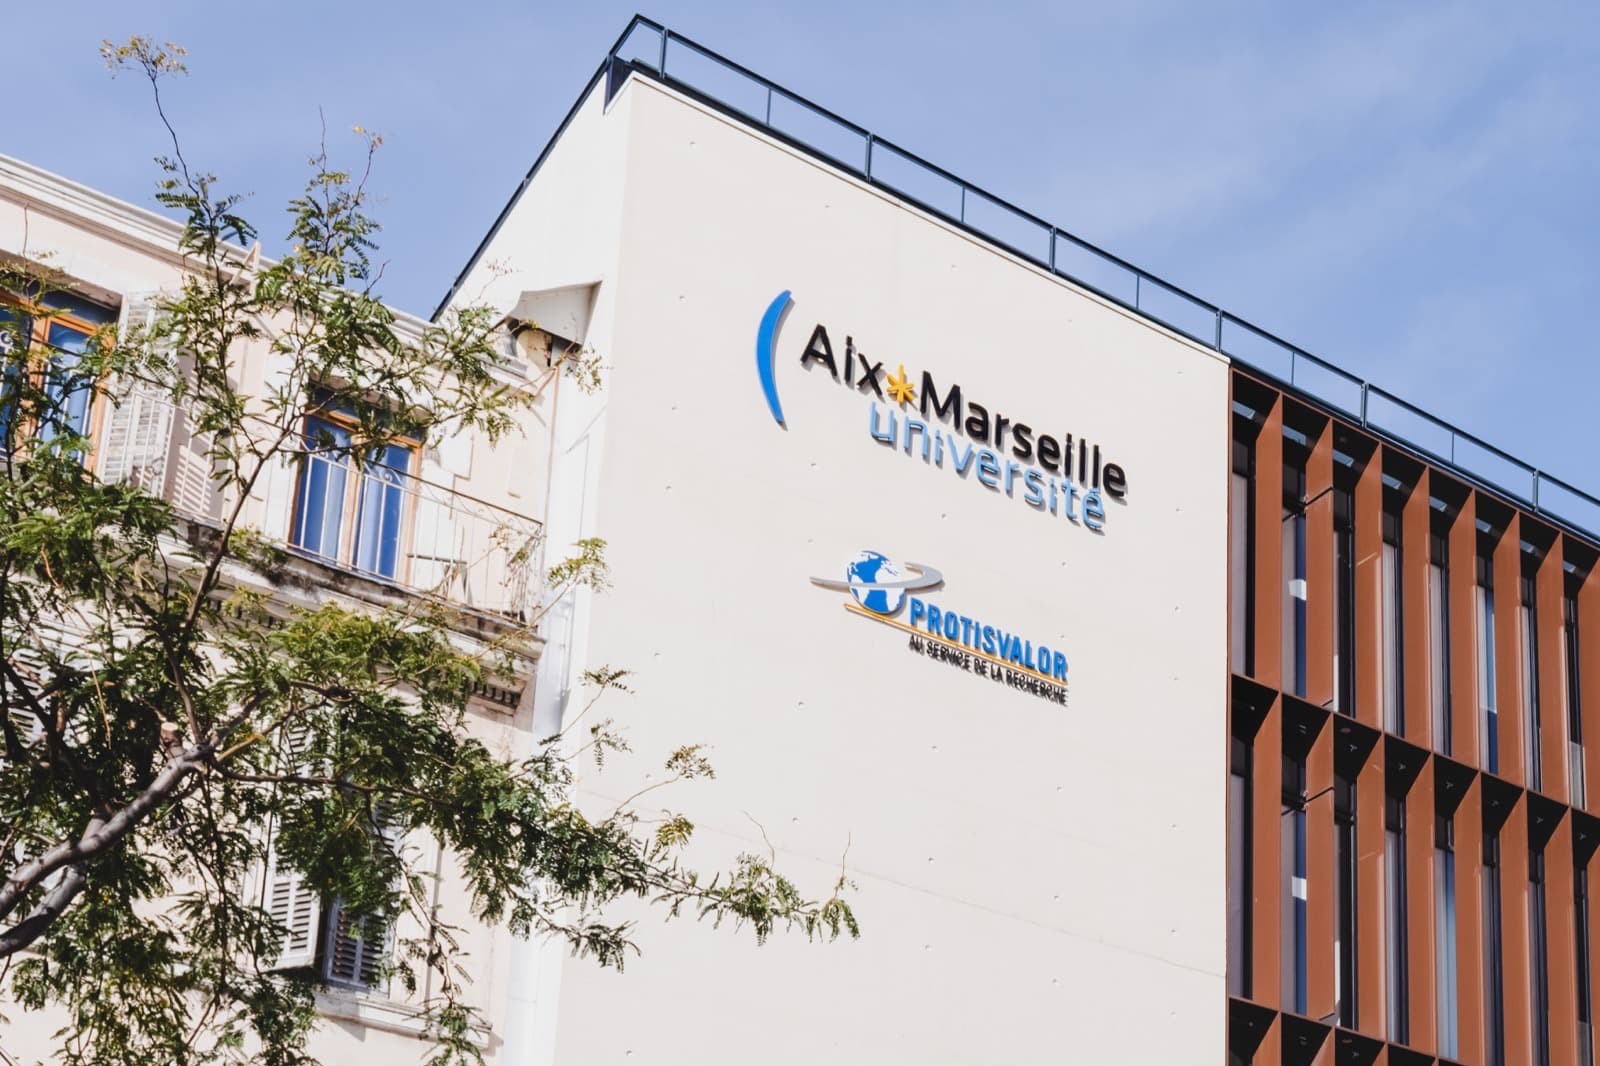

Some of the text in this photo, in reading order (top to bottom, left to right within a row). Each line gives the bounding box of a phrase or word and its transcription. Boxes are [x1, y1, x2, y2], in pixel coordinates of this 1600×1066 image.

[801, 323, 1126, 498] Aix Marseille
[869, 401, 1104, 530] université
[909, 597, 1068, 682] PROTISVALOR
[909, 633, 1069, 706] AU SERVICE DE LA RECHERCHE
